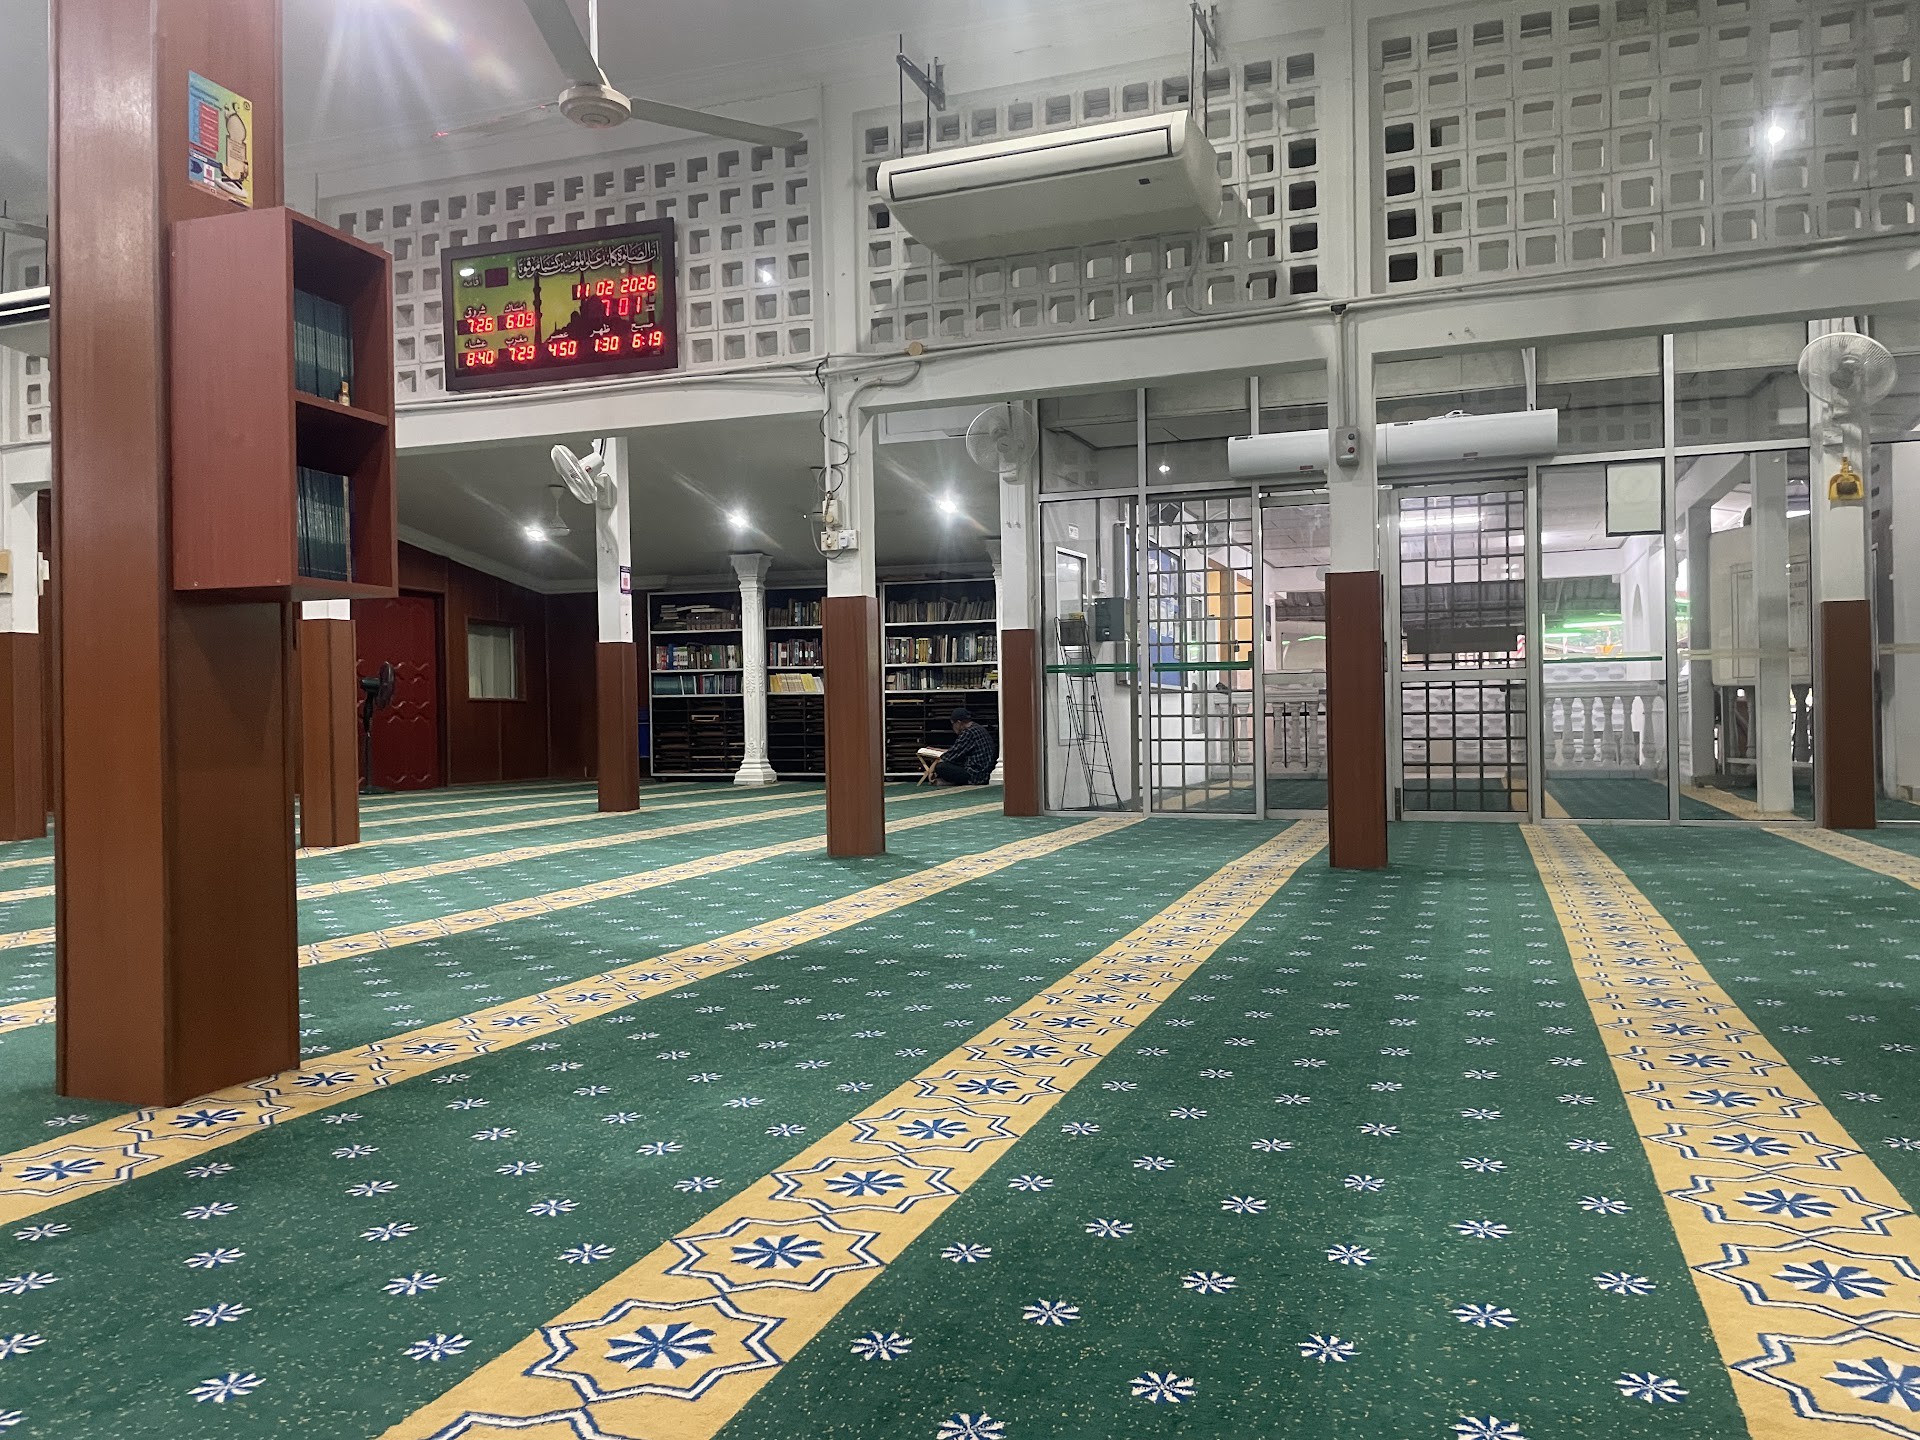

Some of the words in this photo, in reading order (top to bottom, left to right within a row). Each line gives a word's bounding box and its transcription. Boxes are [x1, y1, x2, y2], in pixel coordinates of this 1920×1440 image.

[596, 280, 614, 296] 02
[620, 275, 656, 294] 2026
[631, 330, 662, 349] 6:19
[466, 350, 494, 367] 8:40
